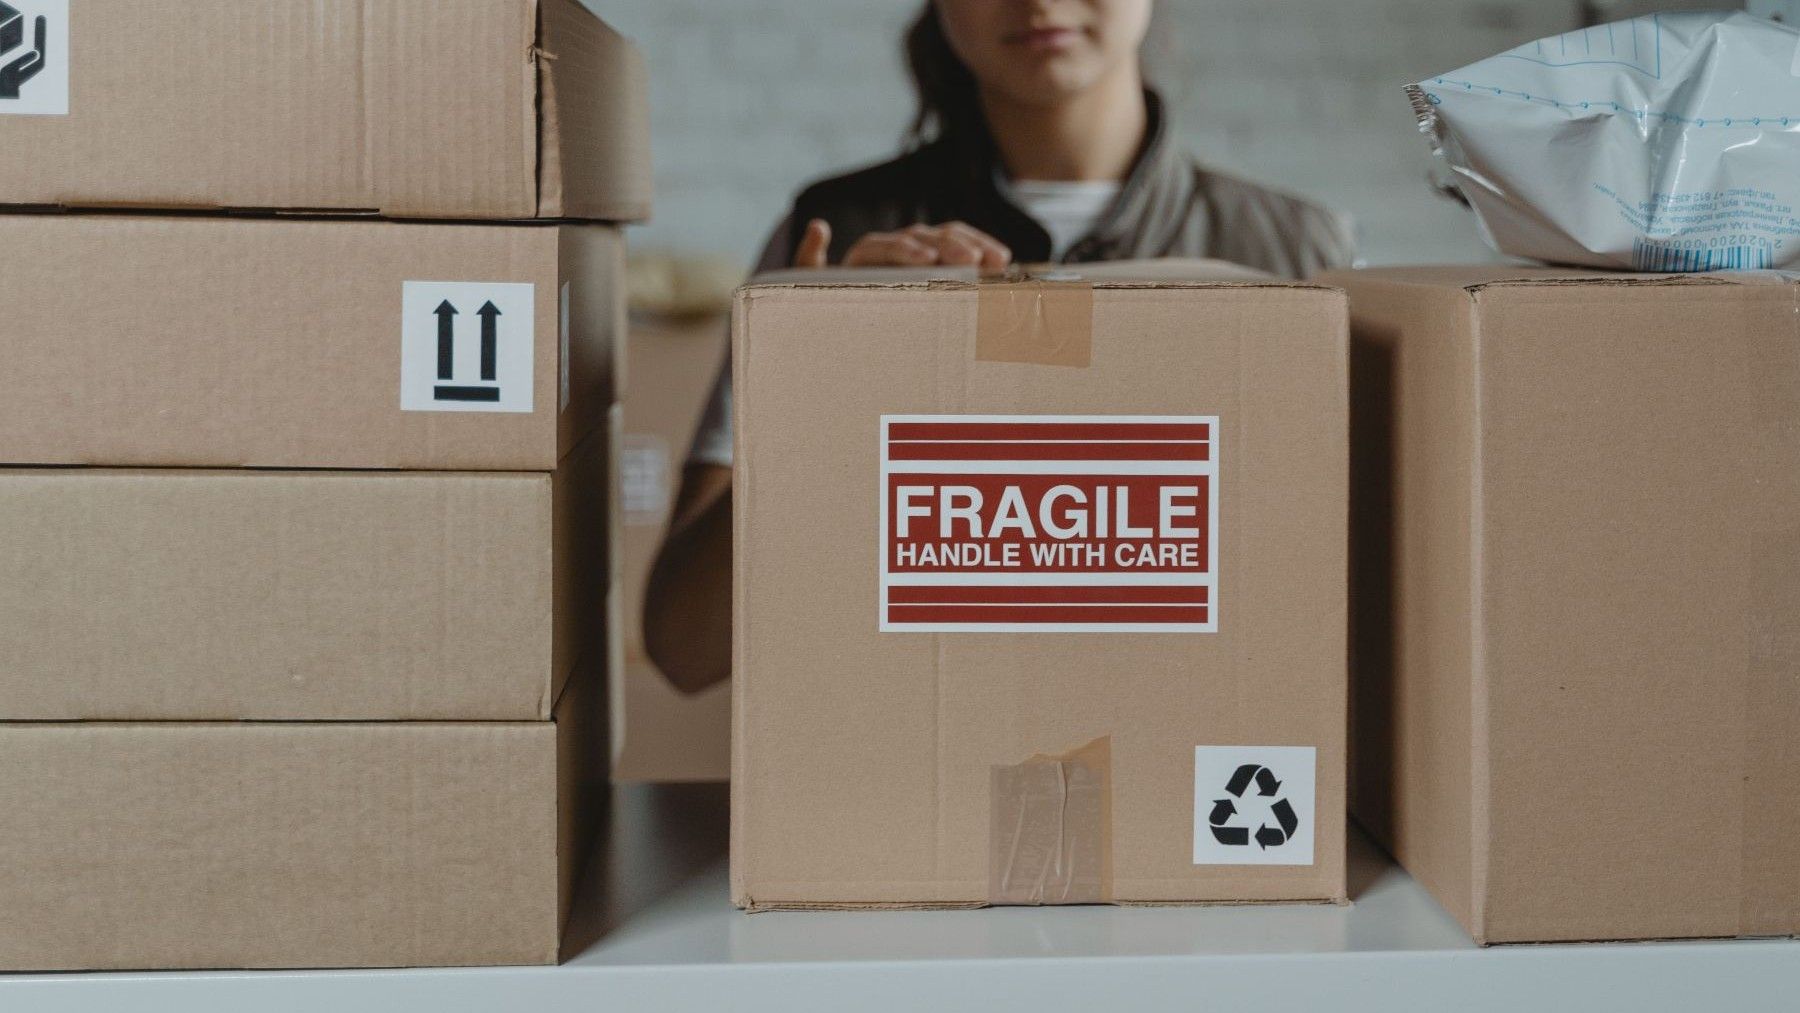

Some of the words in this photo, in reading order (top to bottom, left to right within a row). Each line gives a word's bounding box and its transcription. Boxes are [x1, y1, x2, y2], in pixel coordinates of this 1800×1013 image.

[1710, 235, 1766, 248] 020200
[896, 484, 1200, 539] FRAGILE
[897, 543, 1021, 567] HANDLE
[1030, 543, 1106, 567] WITH
[1114, 542, 1199, 567] CARE
